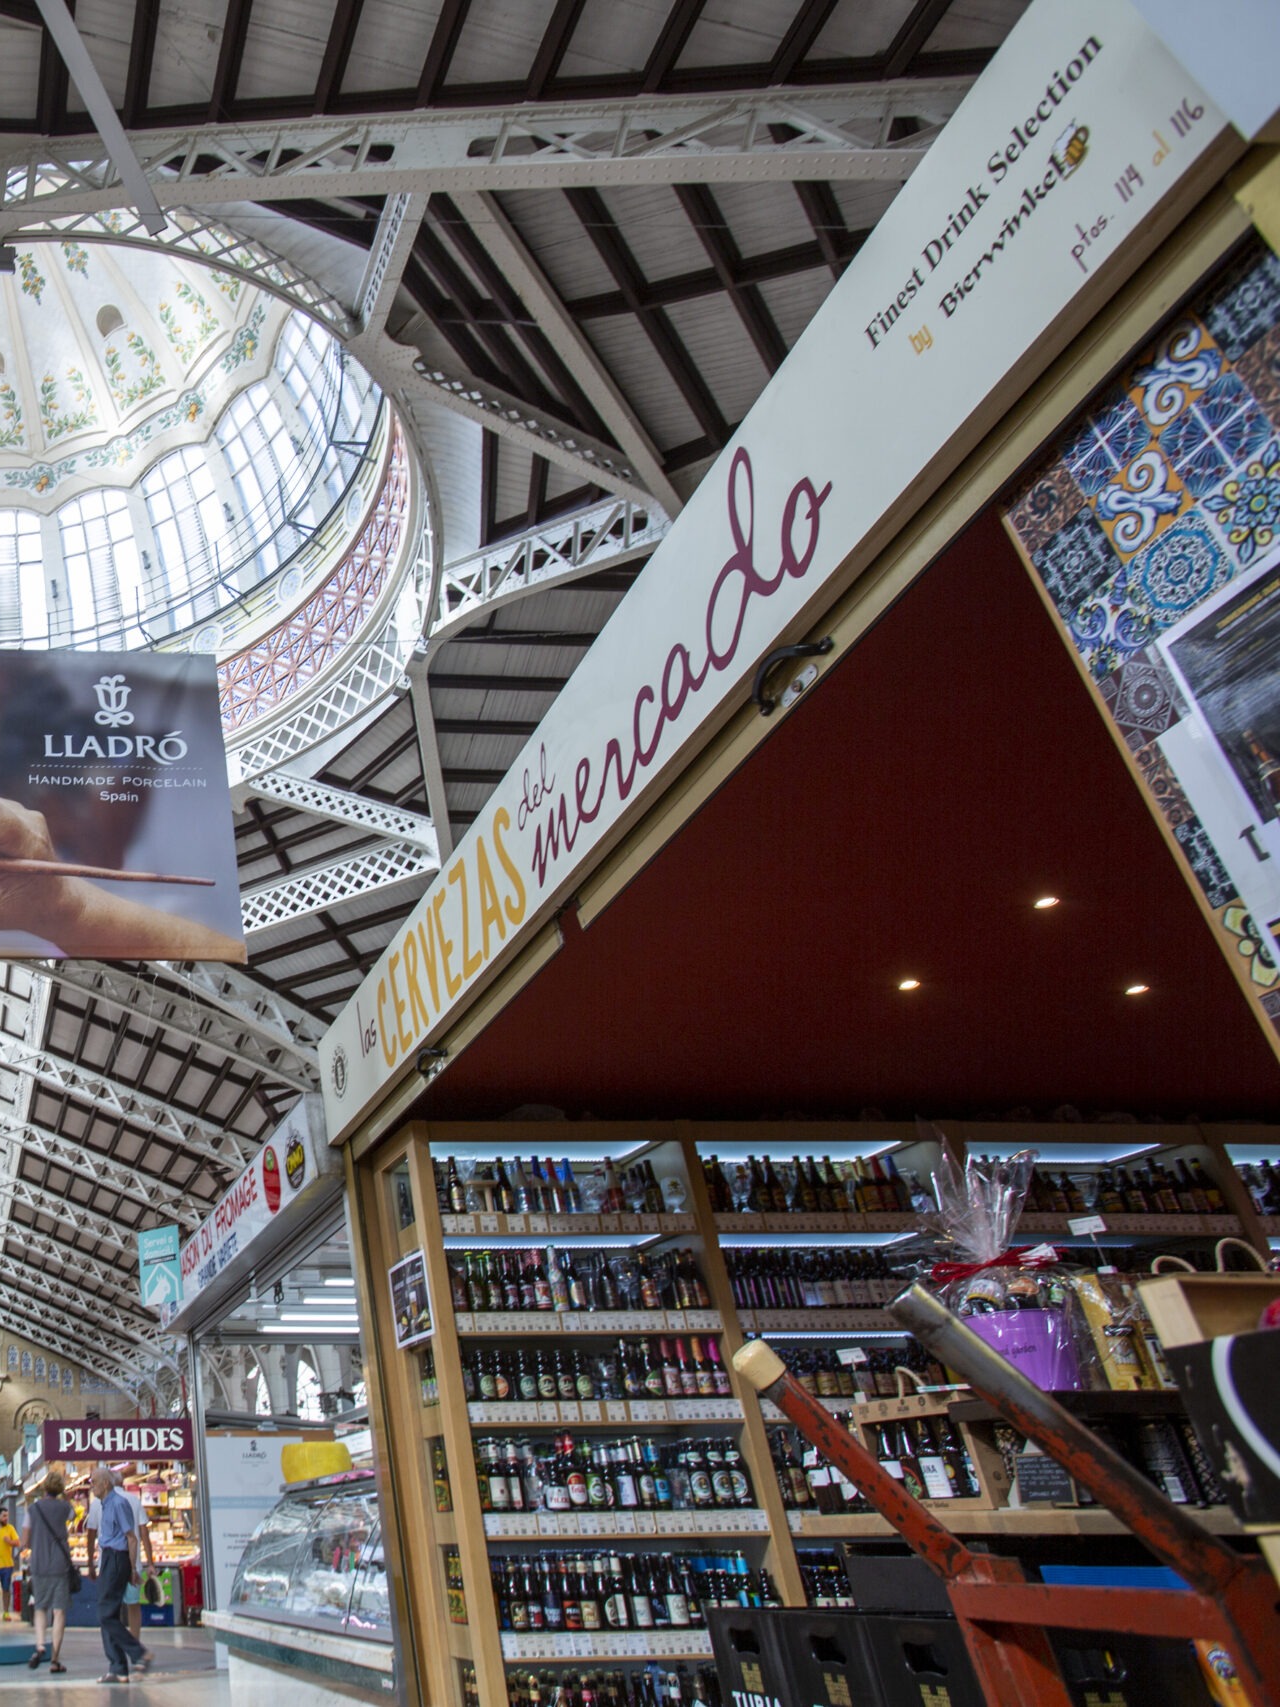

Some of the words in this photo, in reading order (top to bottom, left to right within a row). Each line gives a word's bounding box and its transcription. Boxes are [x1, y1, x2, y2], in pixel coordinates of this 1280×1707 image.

[1151, 131, 1171, 167] al
[1170, 98, 1205, 138] 116
[864, 265, 925, 350] Finest
[920, 182, 990, 272] Drink
[987, 34, 1104, 184] Selection
[909, 325, 933, 355] by
[937, 150, 1069, 318] Bierwinkel
[531, 446, 833, 888] mercado
[28, 773, 116, 786] HANDMADE
[122, 775, 207, 788] PORCELAIN
[43, 731, 188, 765] LLADRÓ
[517, 743, 555, 832] del
[99, 790, 139, 803] Spain
[376, 806, 527, 1069] CERVEZAS
[357, 1000, 377, 1059] las
[180, 1239, 201, 1281] AISON
[201, 1219, 213, 1258] DU
[214, 1167, 258, 1241] FROMAGE
[58, 1427, 184, 1453] PUCHADES
